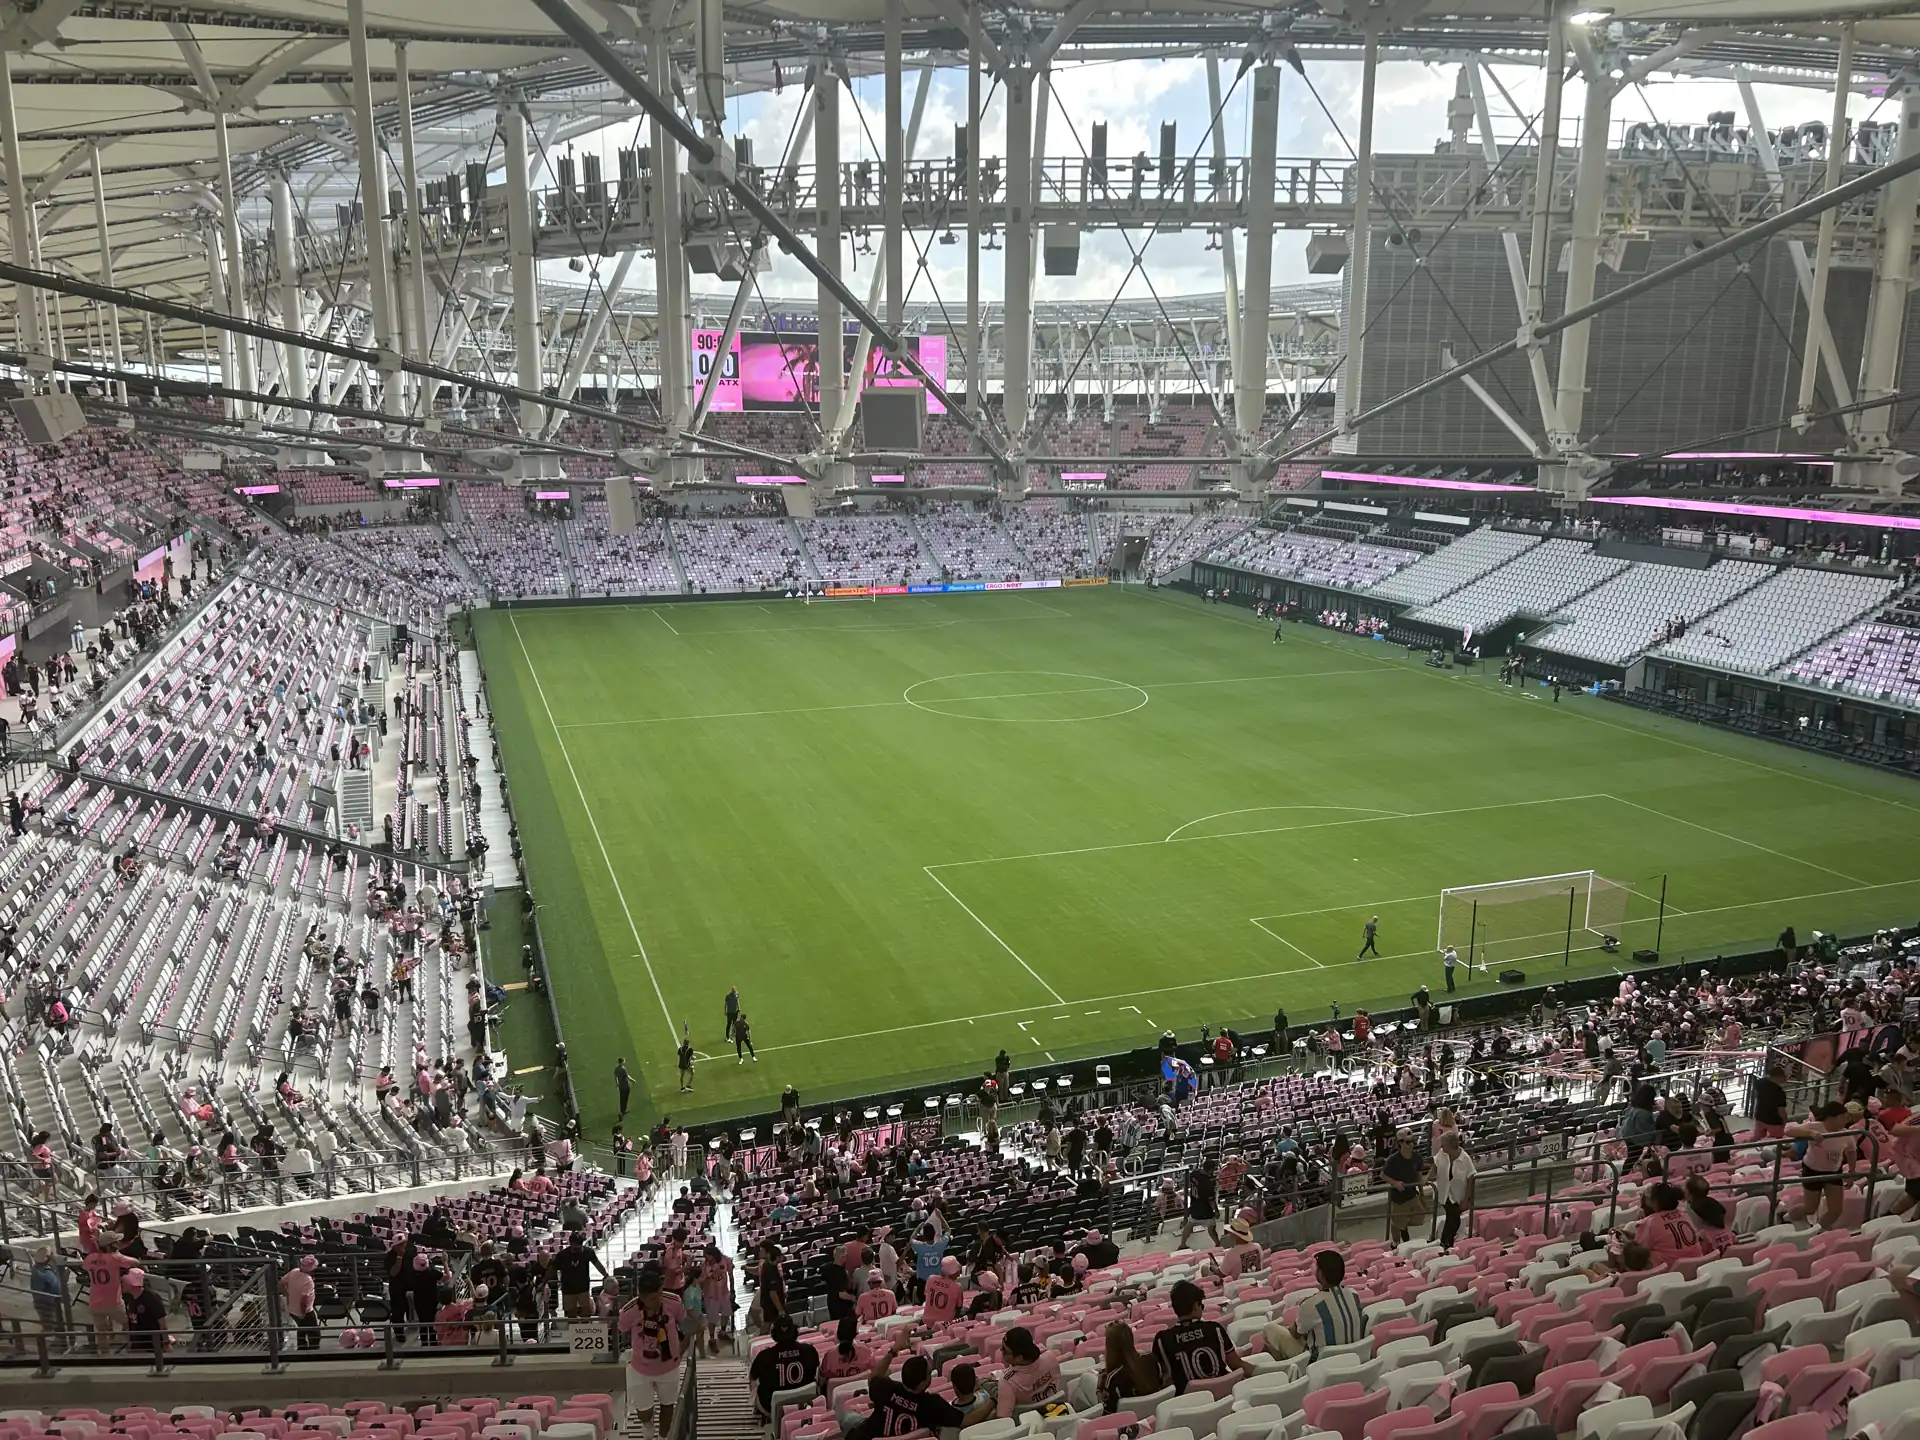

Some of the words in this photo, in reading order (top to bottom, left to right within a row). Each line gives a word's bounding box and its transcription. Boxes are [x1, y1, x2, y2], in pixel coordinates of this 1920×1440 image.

[699, 353, 710, 375] 0
[722, 353, 734, 377] 0
[719, 379, 739, 387] ATX
[1843, 1015, 1856, 1025] 10
[1382, 1136, 1395, 1149] 10
[1543, 1142, 1560, 1154] 230
[1664, 1220, 1697, 1250] 10
[923, 1256, 940, 1267] 10
[89, 1268, 110, 1285] 10
[929, 1288, 950, 1310] 10
[187, 1300, 202, 1317] 10
[871, 1300, 889, 1318] 10
[574, 1336, 605, 1350] 228
[1175, 1328, 1204, 1344] MESSI
[778, 1349, 800, 1359] MESSI
[1174, 1346, 1220, 1380] 10
[775, 1360, 804, 1387] 10
[1032, 1372, 1053, 1391] MESSI
[890, 1392, 918, 1412] MESSI
[882, 1404, 918, 1437] 10
